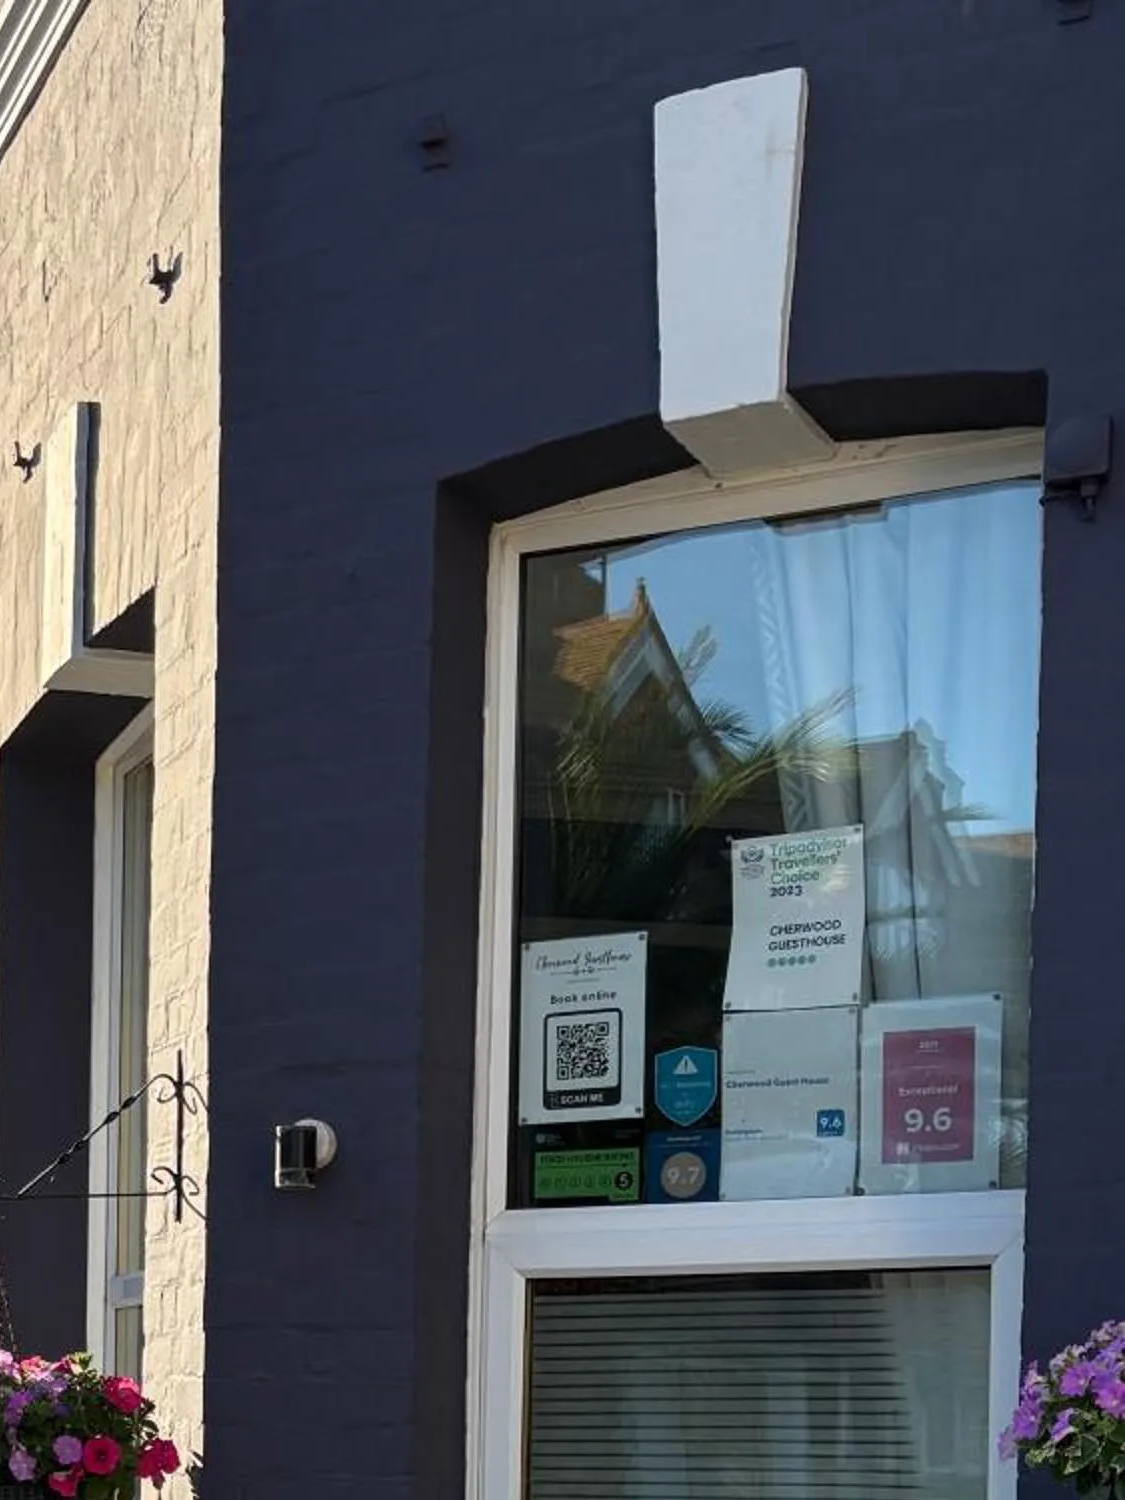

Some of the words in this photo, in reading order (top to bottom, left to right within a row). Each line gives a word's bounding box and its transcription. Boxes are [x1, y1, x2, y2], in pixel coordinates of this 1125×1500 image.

[771, 871, 820, 885] Choice
[770, 885, 803, 897] 2023
[770, 919, 842, 936] CHERWOOD
[768, 934, 846, 952] GUESTHOUSE
[550, 993, 578, 1005] Book
[581, 991, 617, 1002] online
[560, 1094, 587, 1105] SCAN
[589, 1093, 604, 1103] ME
[820, 1117, 843, 1130] 9.6
[903, 1107, 953, 1133] 9.6
[618, 1173, 629, 1187] 5
[666, 1167, 701, 1186] 9.7
